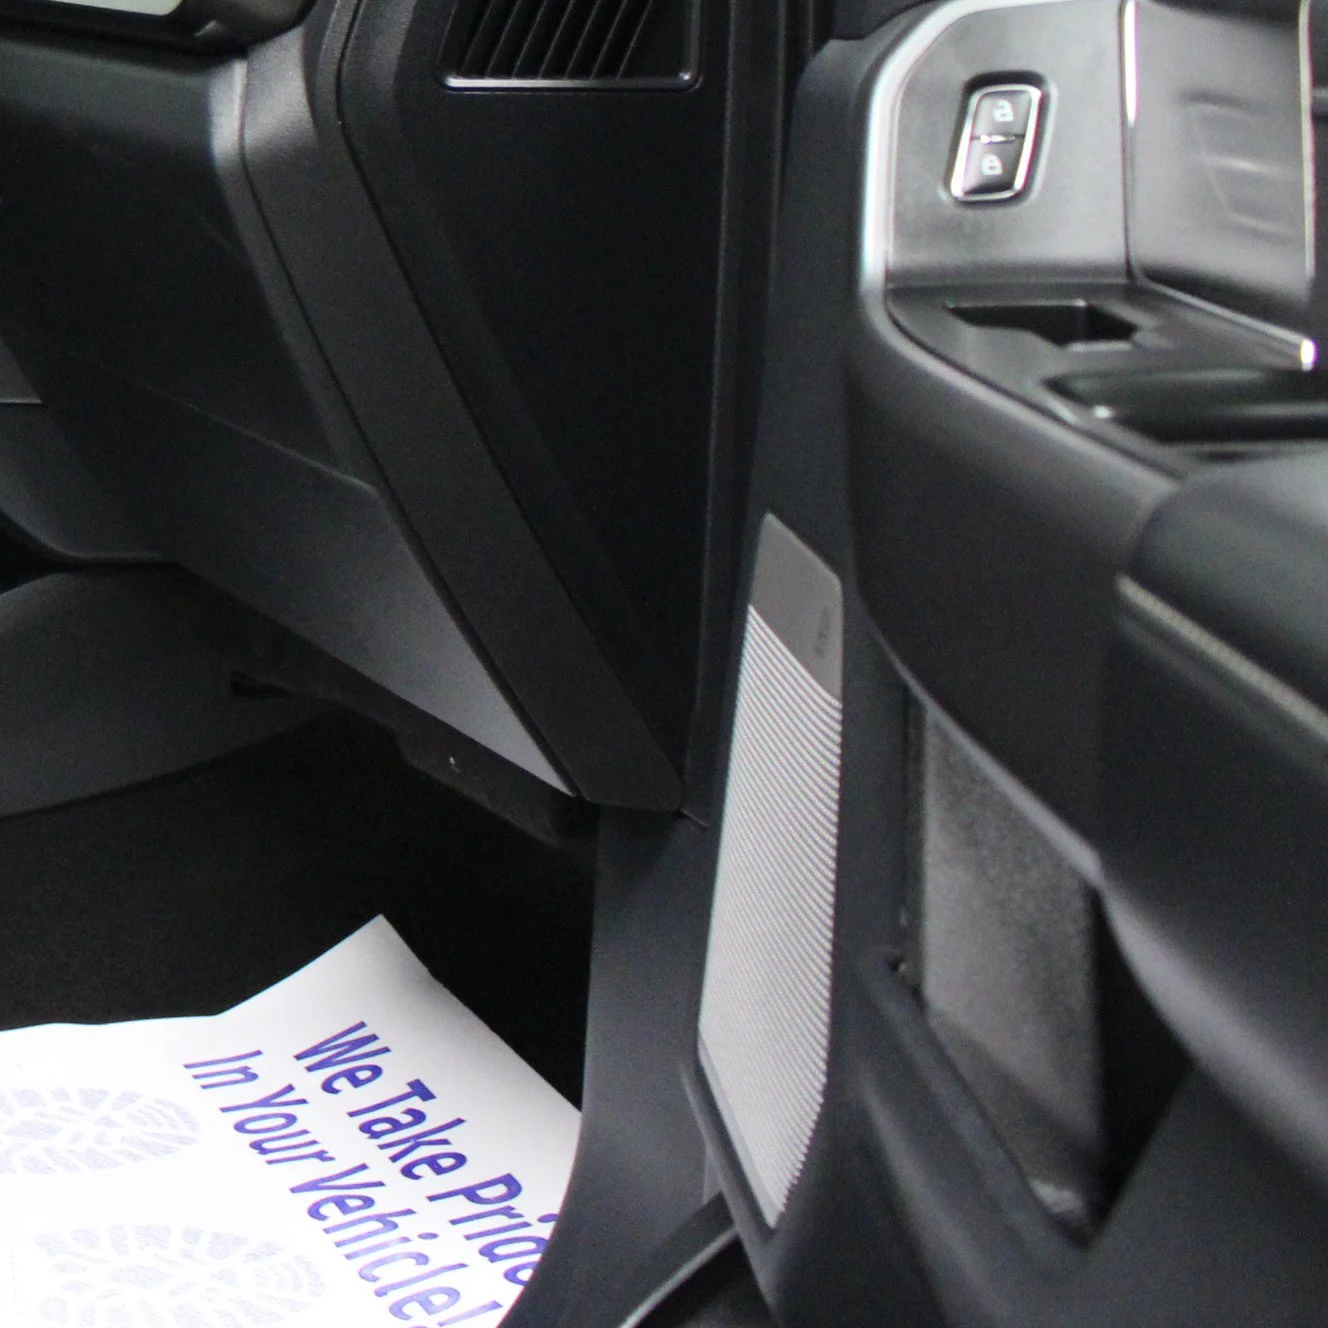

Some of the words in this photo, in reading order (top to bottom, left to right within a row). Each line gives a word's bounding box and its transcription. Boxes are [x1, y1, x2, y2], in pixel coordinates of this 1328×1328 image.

[182, 1049, 265, 1090] In
[218, 1082, 337, 1166] Your
[292, 1020, 393, 1095] We
[346, 1078, 468, 1181] Take
[289, 1162, 505, 1328] Vehicle!
